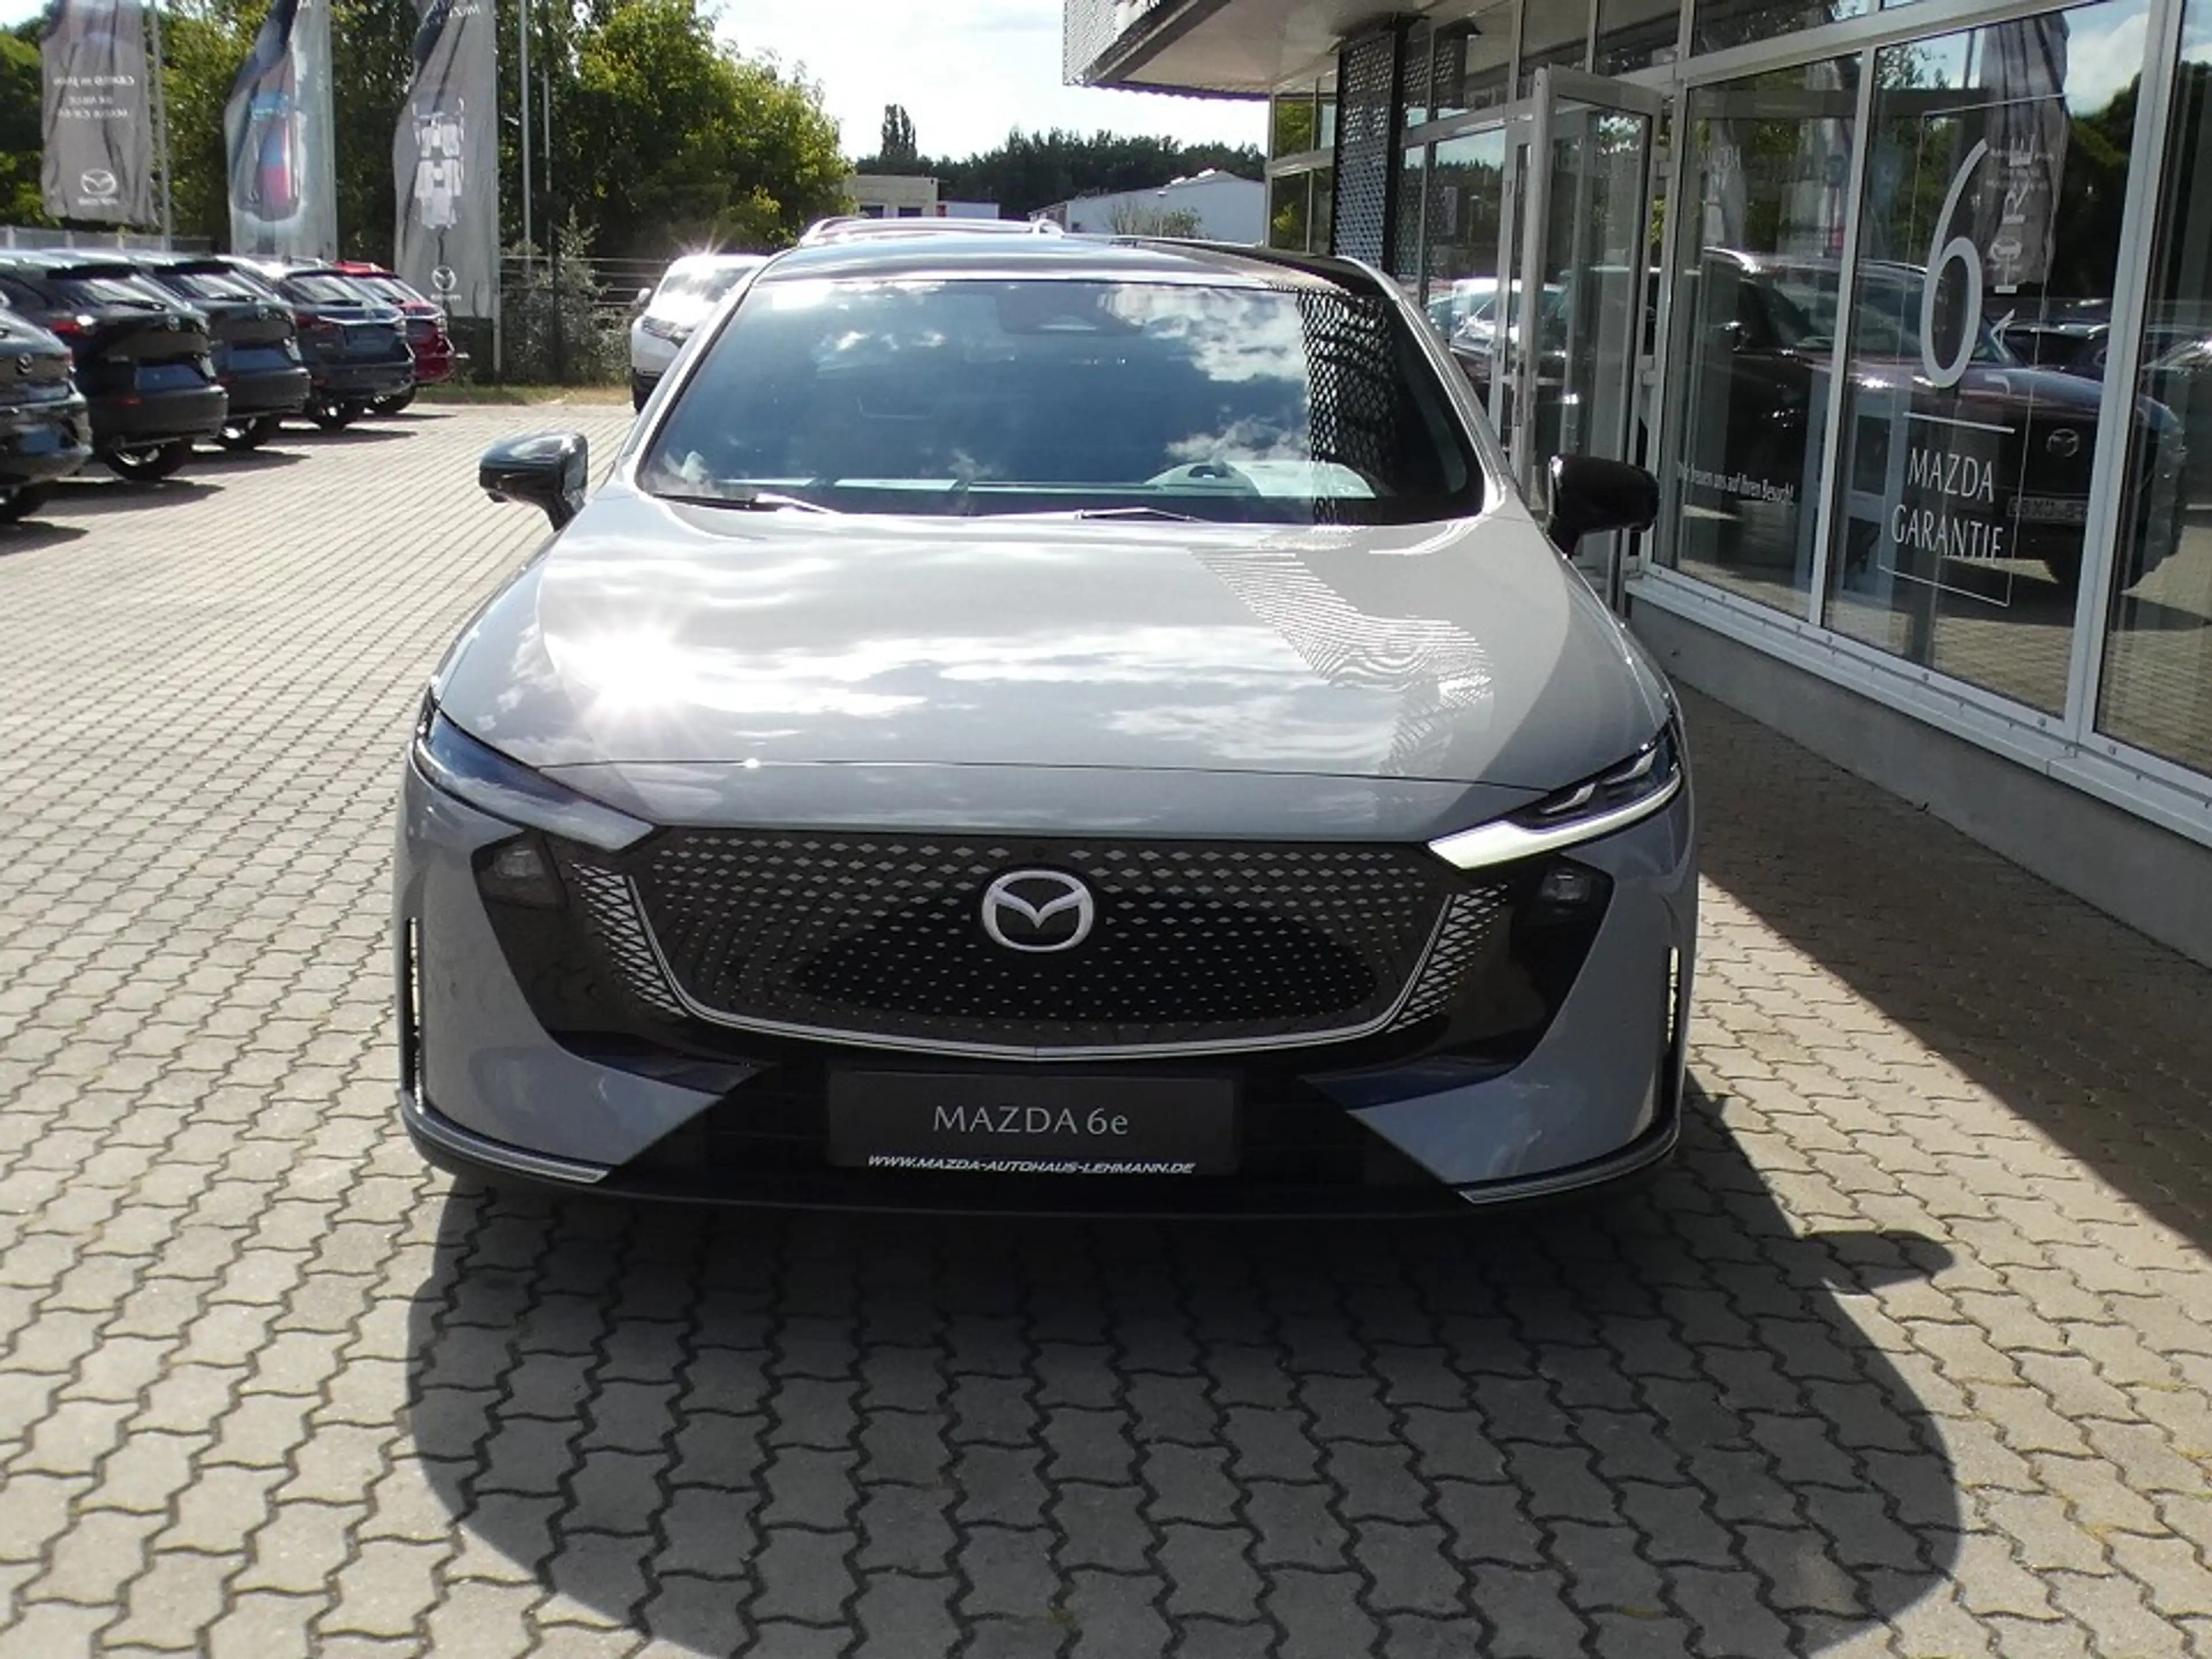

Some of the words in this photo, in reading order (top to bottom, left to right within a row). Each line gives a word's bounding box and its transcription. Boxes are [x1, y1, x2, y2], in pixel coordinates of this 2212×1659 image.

[1920, 138, 1987, 388] 6
[1908, 447, 1994, 503] MAZDA
[1892, 504, 2003, 565] GARANTIE
[933, 1105, 1078, 1134] MAZDA
[1086, 1107, 1129, 1135] 6e
[868, 1154, 1196, 1174] WWW.MAZDA-AUTOHAUS-LEHMANN.DE
